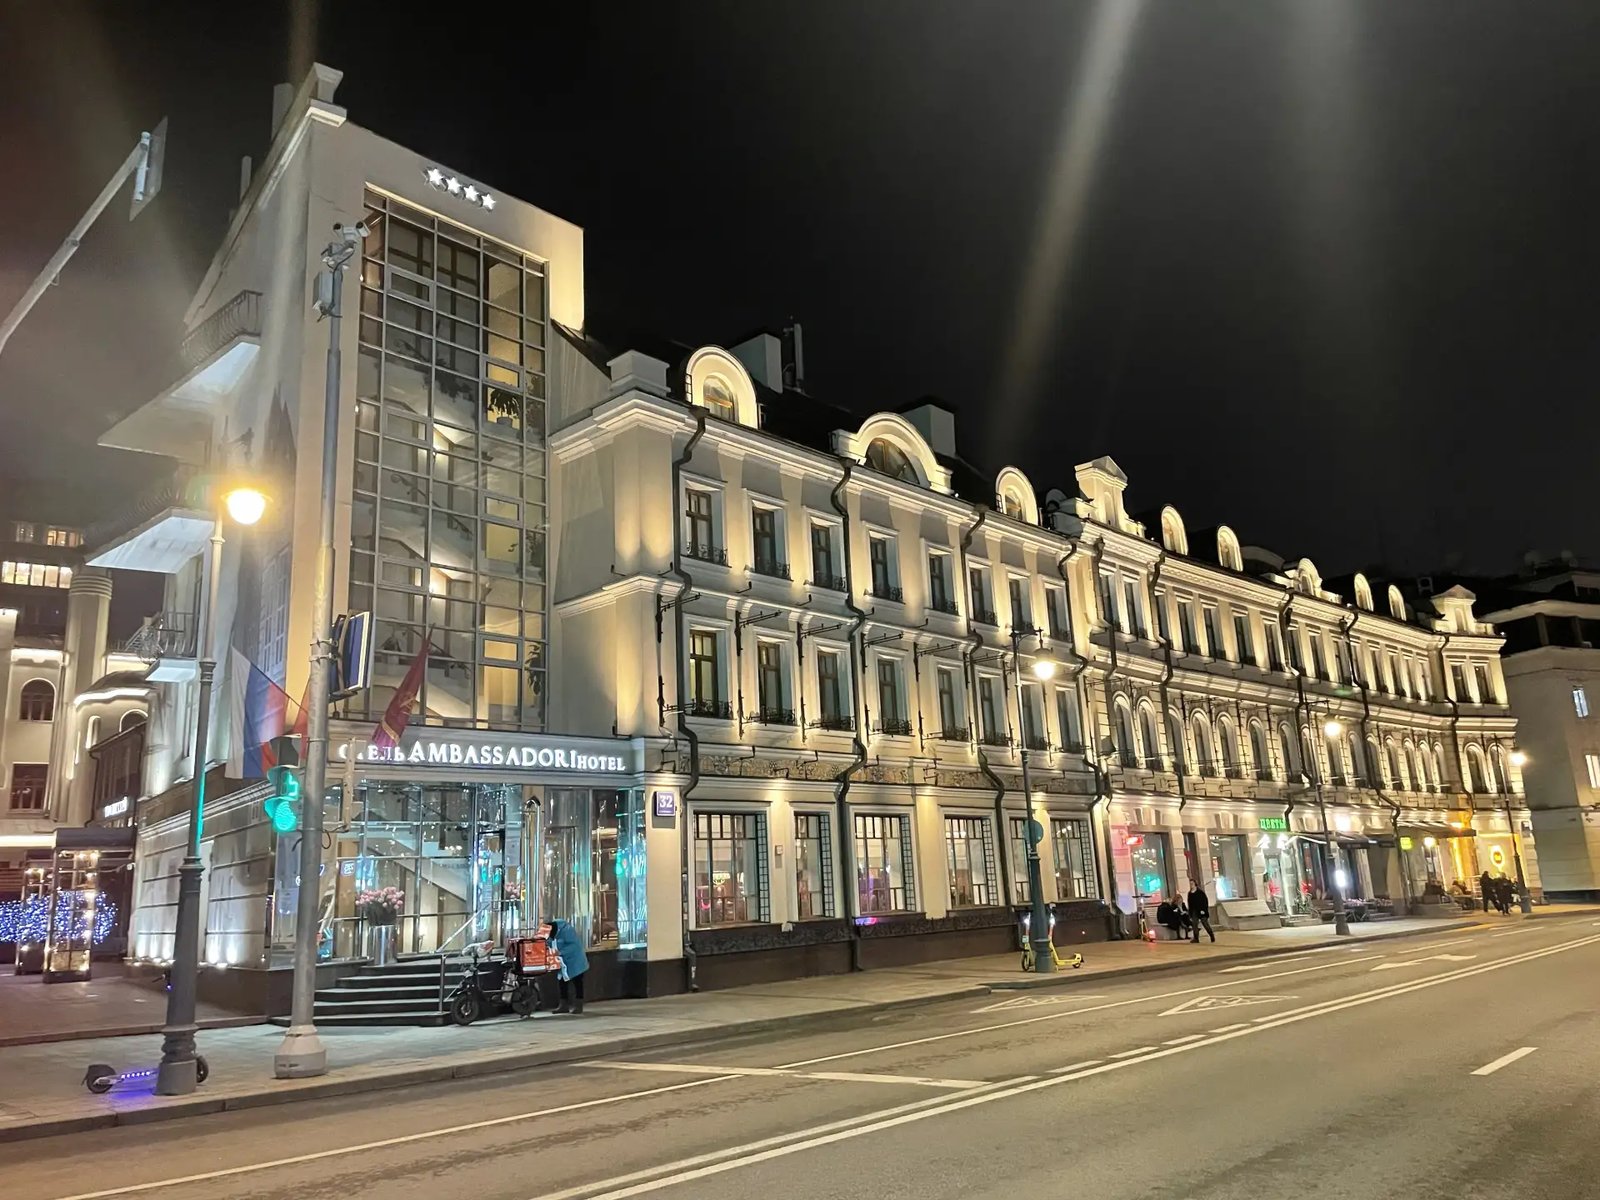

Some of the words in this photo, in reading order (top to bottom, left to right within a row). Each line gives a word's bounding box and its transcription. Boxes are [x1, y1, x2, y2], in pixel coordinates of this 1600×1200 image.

[338, 743, 405, 762] ОЕЛЬ
[407, 740, 577, 769] AMBASSADORI
[577, 754, 626, 771] HOTEL
[659, 794, 673, 808] 32
